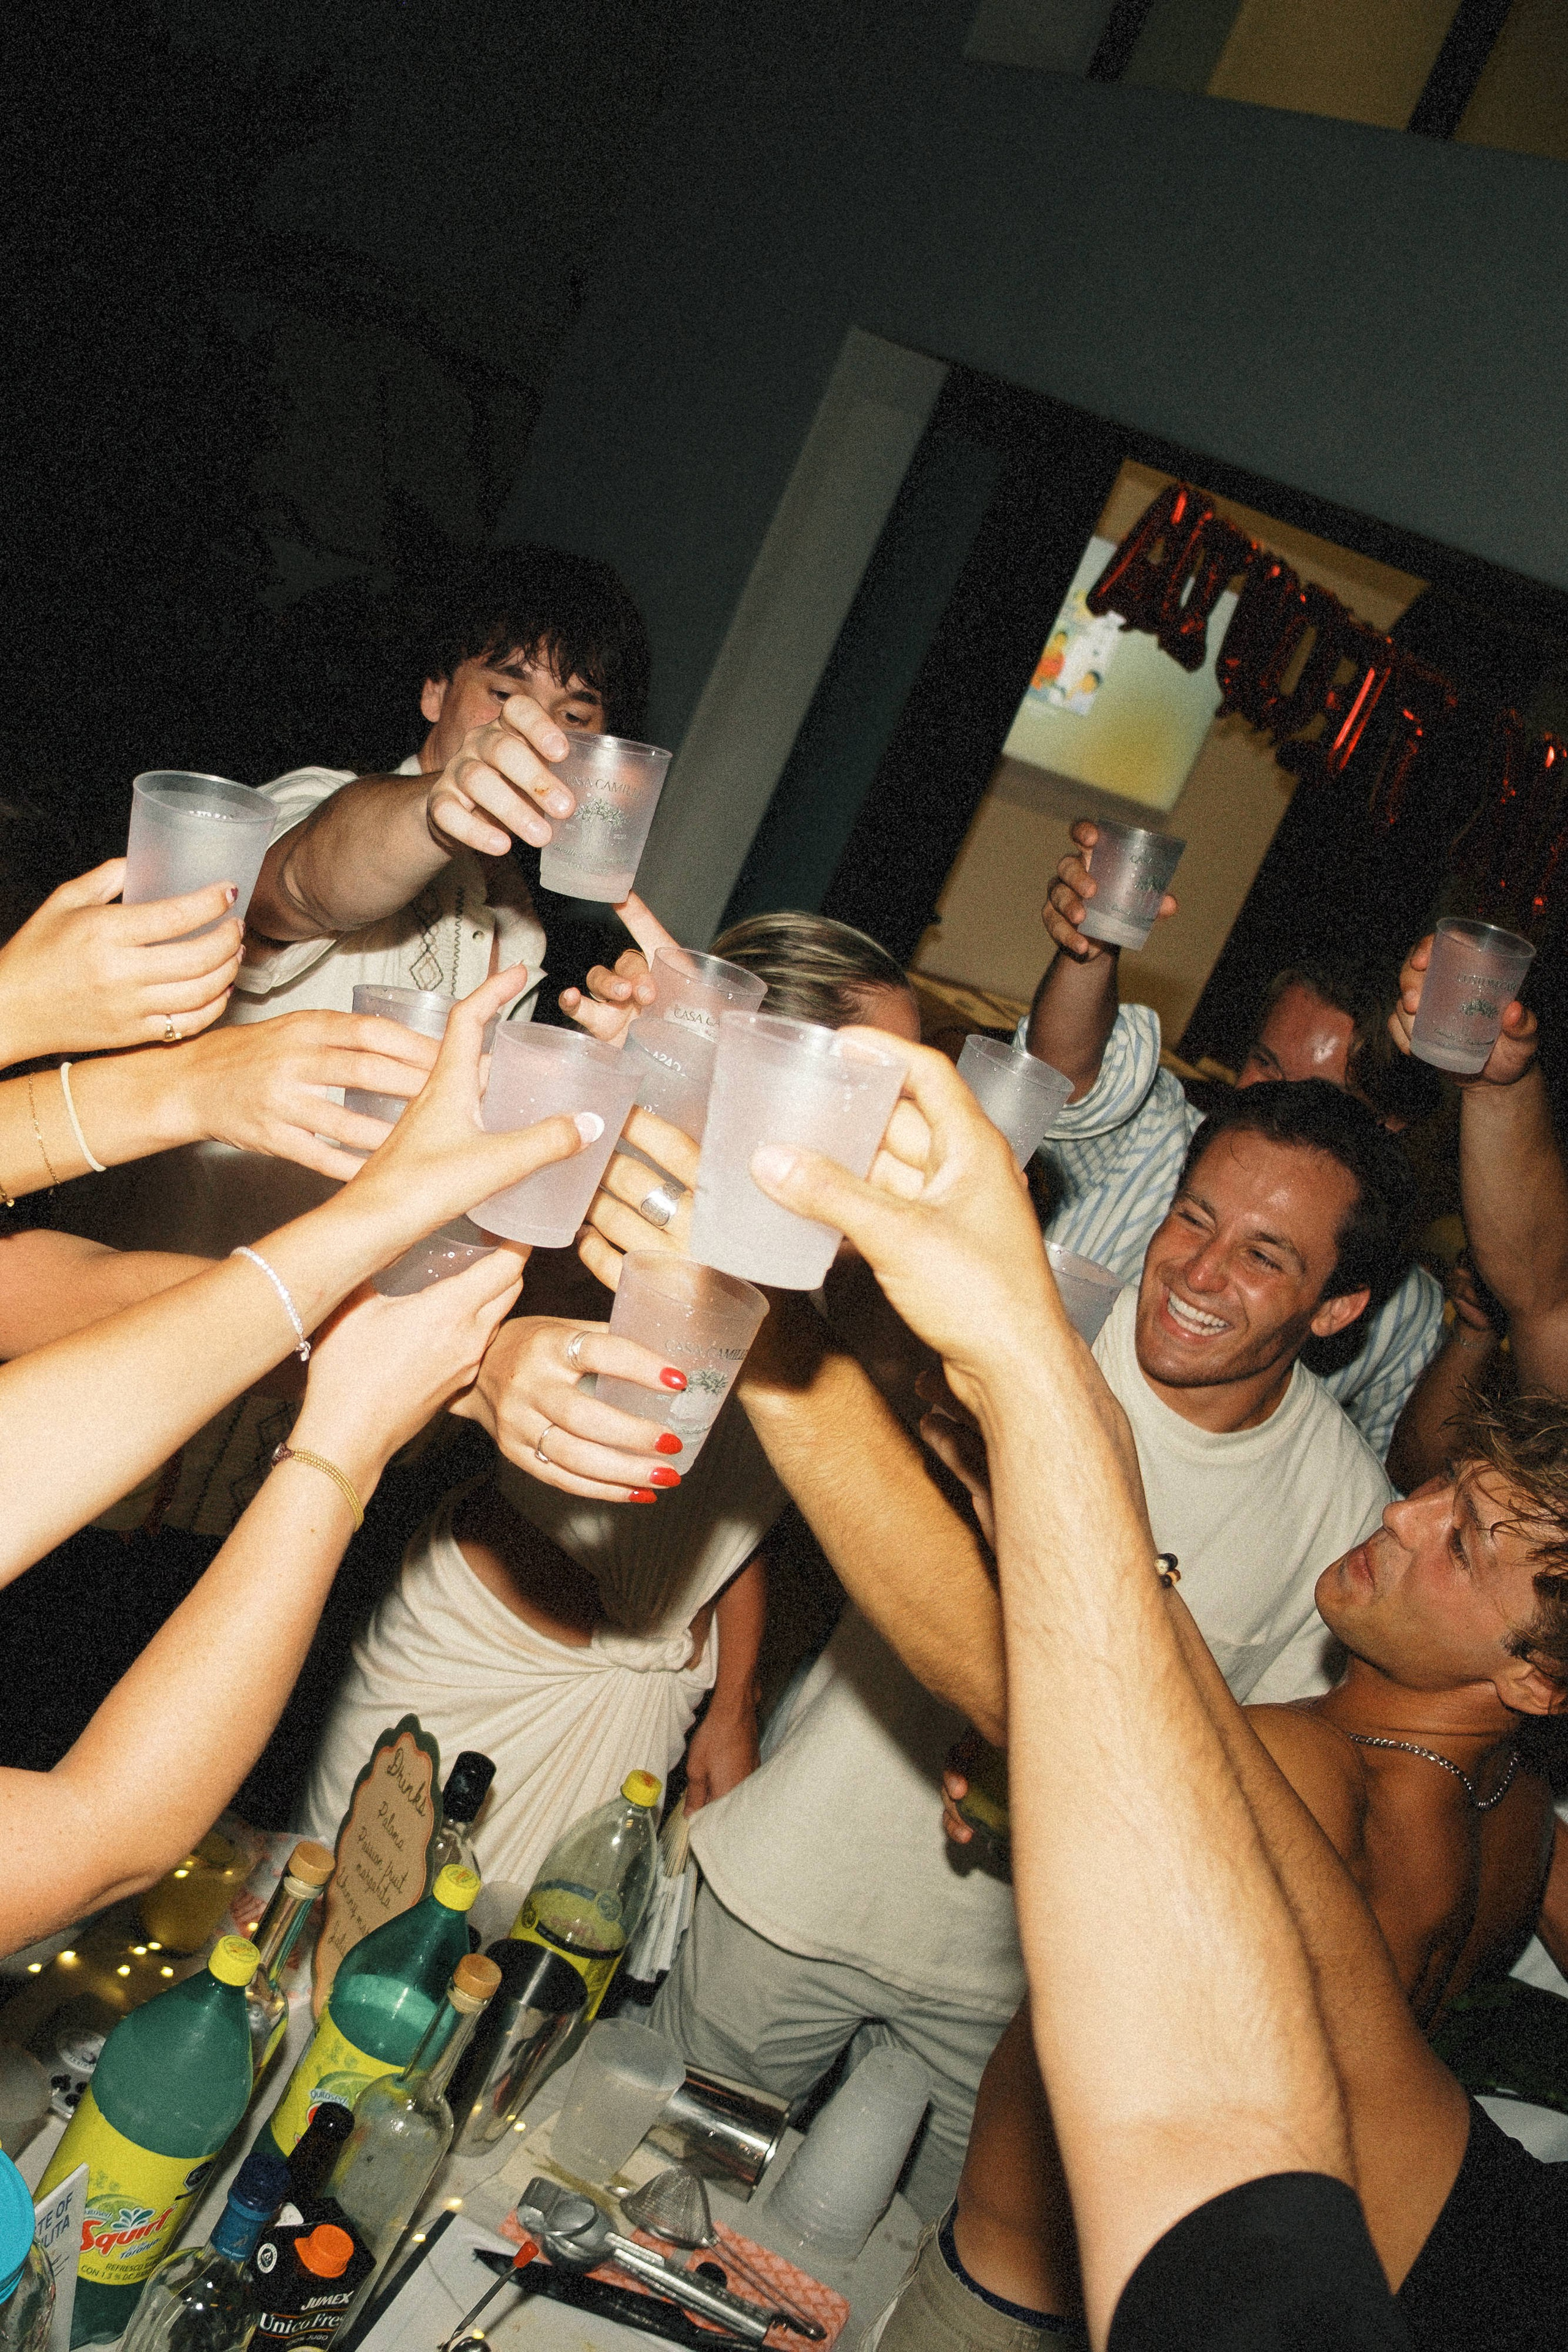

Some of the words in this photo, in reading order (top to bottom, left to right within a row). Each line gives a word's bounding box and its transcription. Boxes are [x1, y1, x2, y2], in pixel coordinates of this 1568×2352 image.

[567, 775, 592, 788] CASA
[673, 1008, 703, 1023] CASA
[386, 1747, 426, 1817] Drinks
[377, 1861, 409, 1894] fruit
[56, 2190, 74, 2218] OF
[80, 2204, 177, 2257] Squirt
[81, 2264, 99, 2277] CON
[105, 2263, 143, 2272] REFRESCO
[301, 2291, 354, 2311] JUMEX
